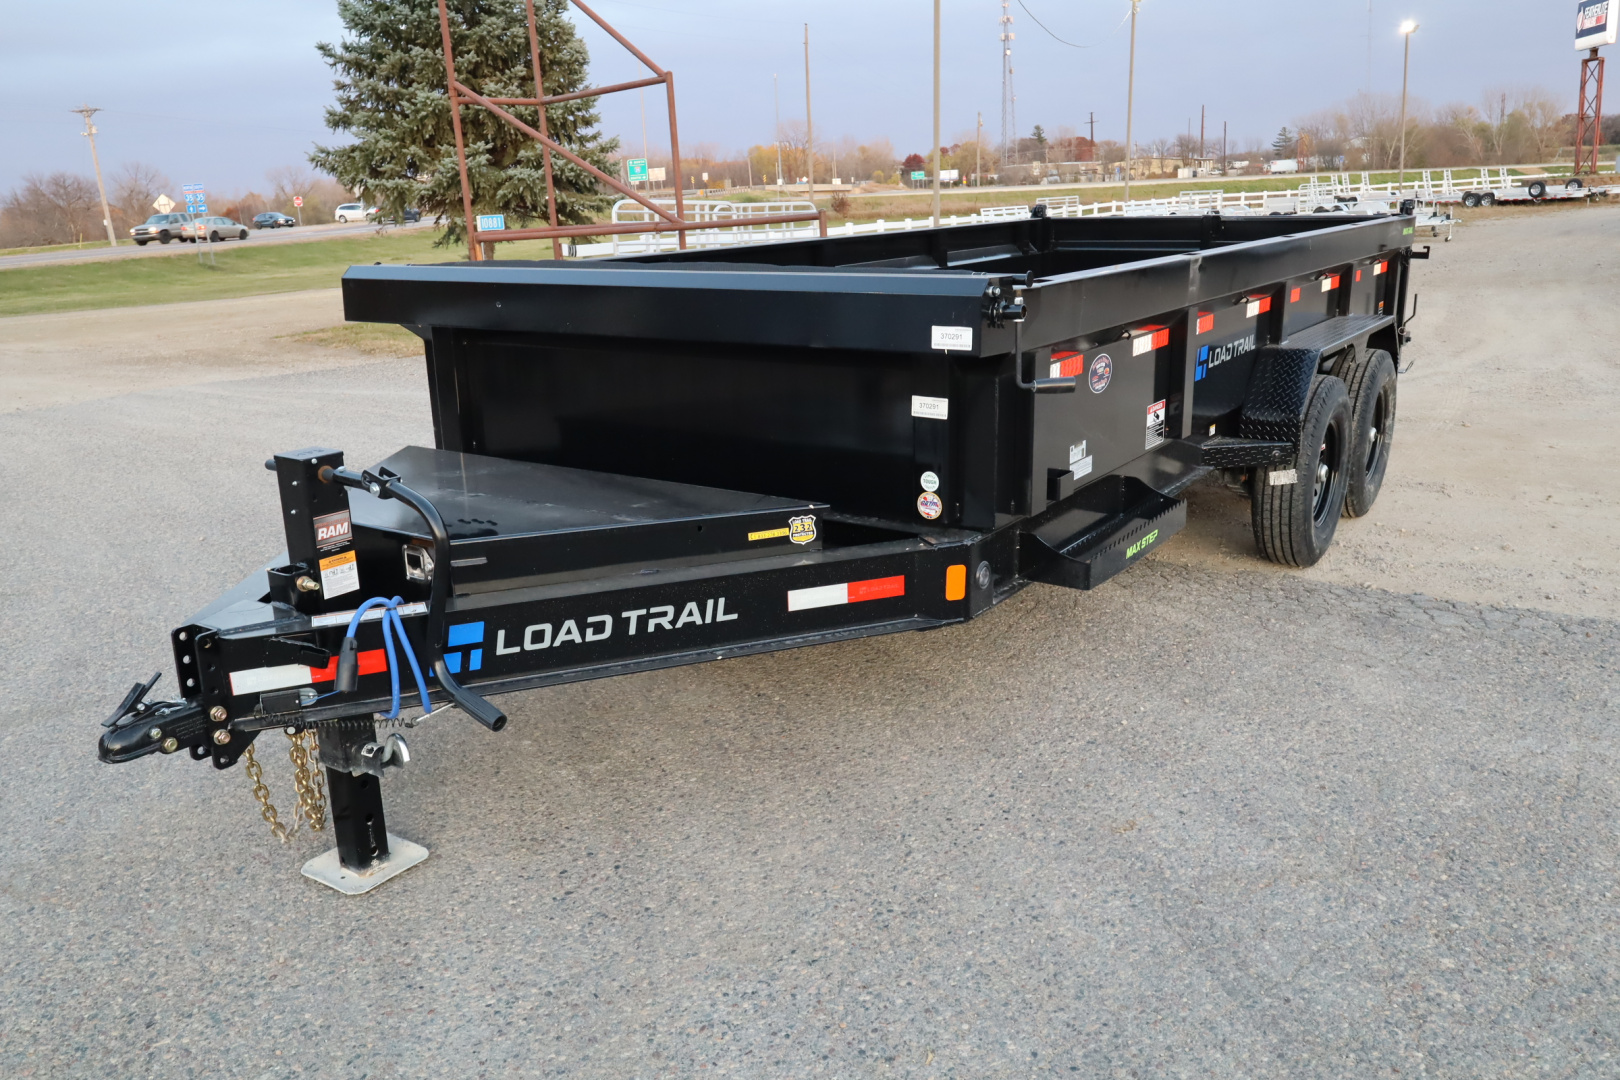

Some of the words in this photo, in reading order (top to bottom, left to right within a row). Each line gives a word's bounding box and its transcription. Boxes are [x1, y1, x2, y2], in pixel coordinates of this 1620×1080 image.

[940, 333, 963, 341] 370291
[1208, 343, 1233, 369] LOAD
[1233, 334, 1256, 358] TRAIL
[918, 402, 940, 411] 370291
[317, 521, 349, 541] RAM
[1126, 540, 1142, 560] MAX
[1141, 529, 1159, 549] STEP
[495, 614, 613, 656] LOAD
[621, 597, 738, 636] TRAIL
